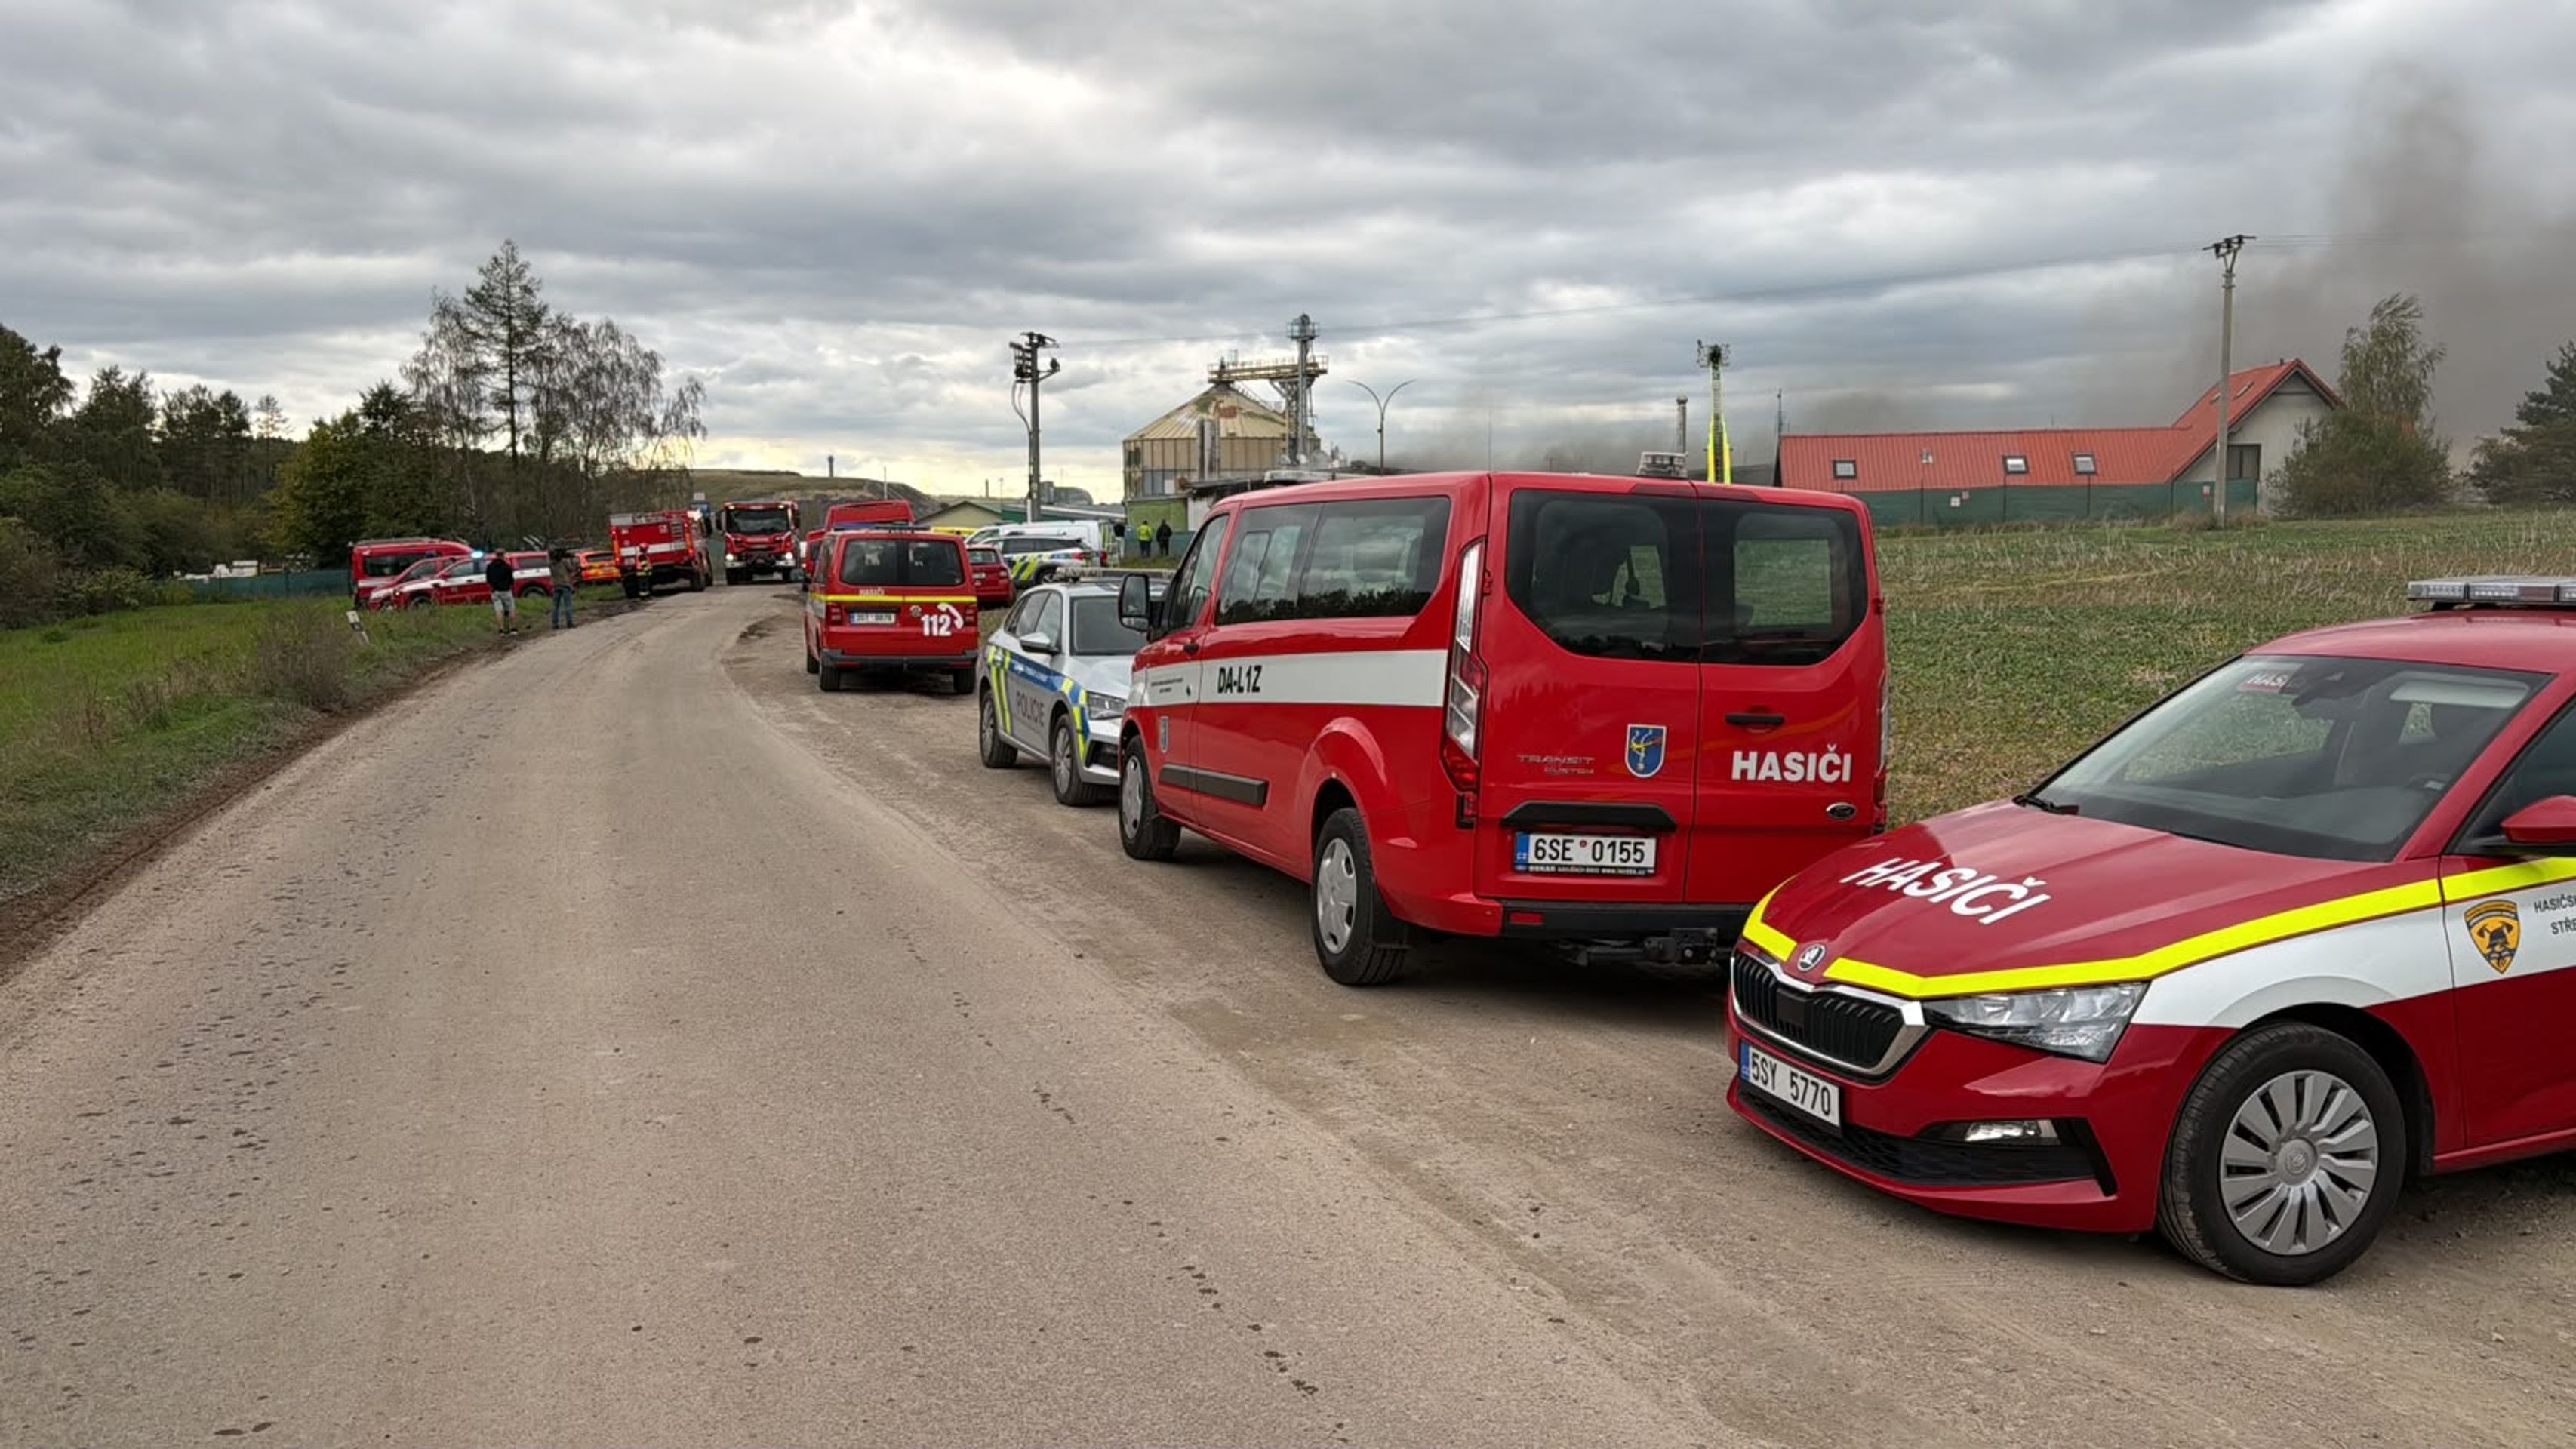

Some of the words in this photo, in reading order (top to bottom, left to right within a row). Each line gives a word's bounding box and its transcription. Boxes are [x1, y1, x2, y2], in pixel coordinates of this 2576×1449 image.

[921, 614, 952, 637] 112
[1016, 690, 1045, 727] POLICIE
[1517, 754, 1596, 765] TRANSIT
[1544, 766, 1595, 774] CUSTOM
[1731, 743, 1852, 782] HASIČI
[1534, 838, 1574, 862] 6SE
[1592, 840, 1646, 864] 0155
[1839, 857, 2052, 925] HASIČI
[1751, 1051, 1777, 1091] 5SY
[1790, 1070, 1831, 1117] 5770
